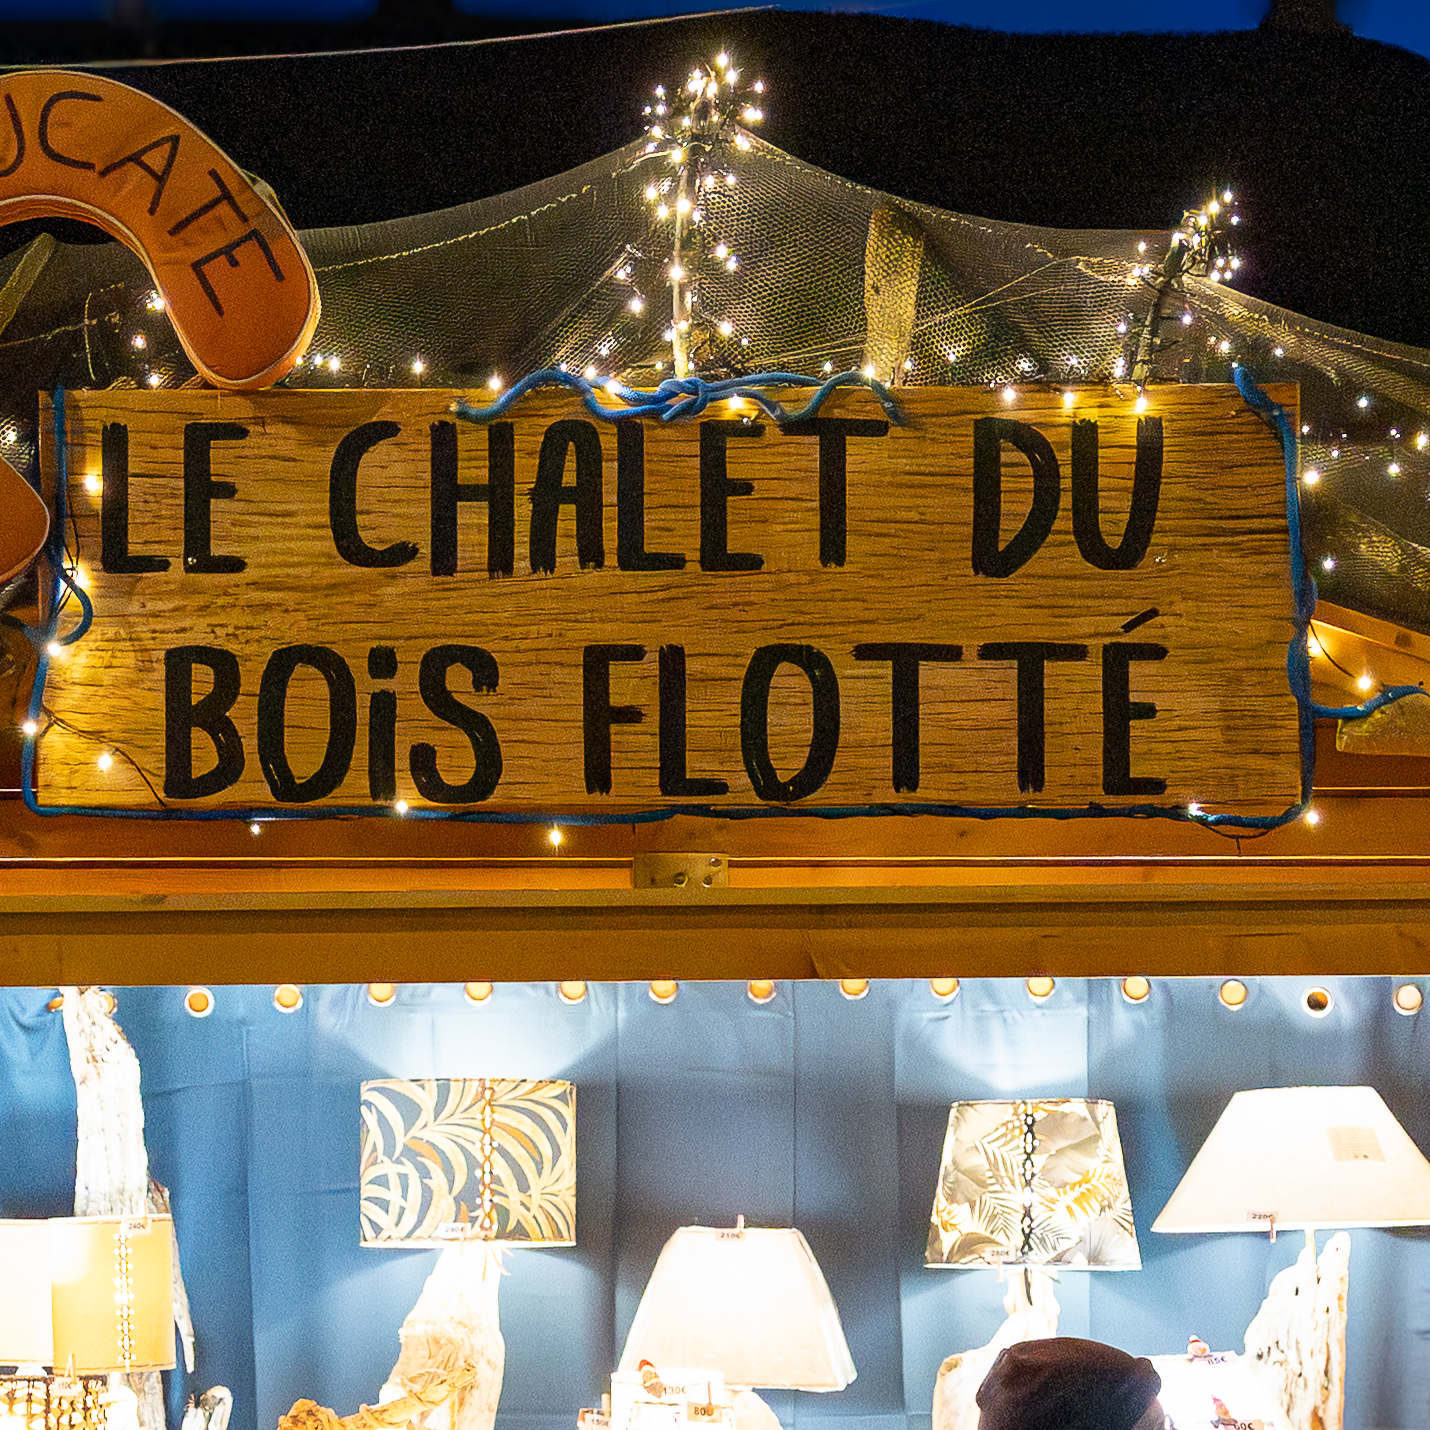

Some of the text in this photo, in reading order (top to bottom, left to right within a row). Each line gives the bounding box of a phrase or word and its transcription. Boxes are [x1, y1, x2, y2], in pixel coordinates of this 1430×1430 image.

[100, 413, 1164, 579] LE CHALET DU
[582, 605, 1173, 804] FLOTTÉ
